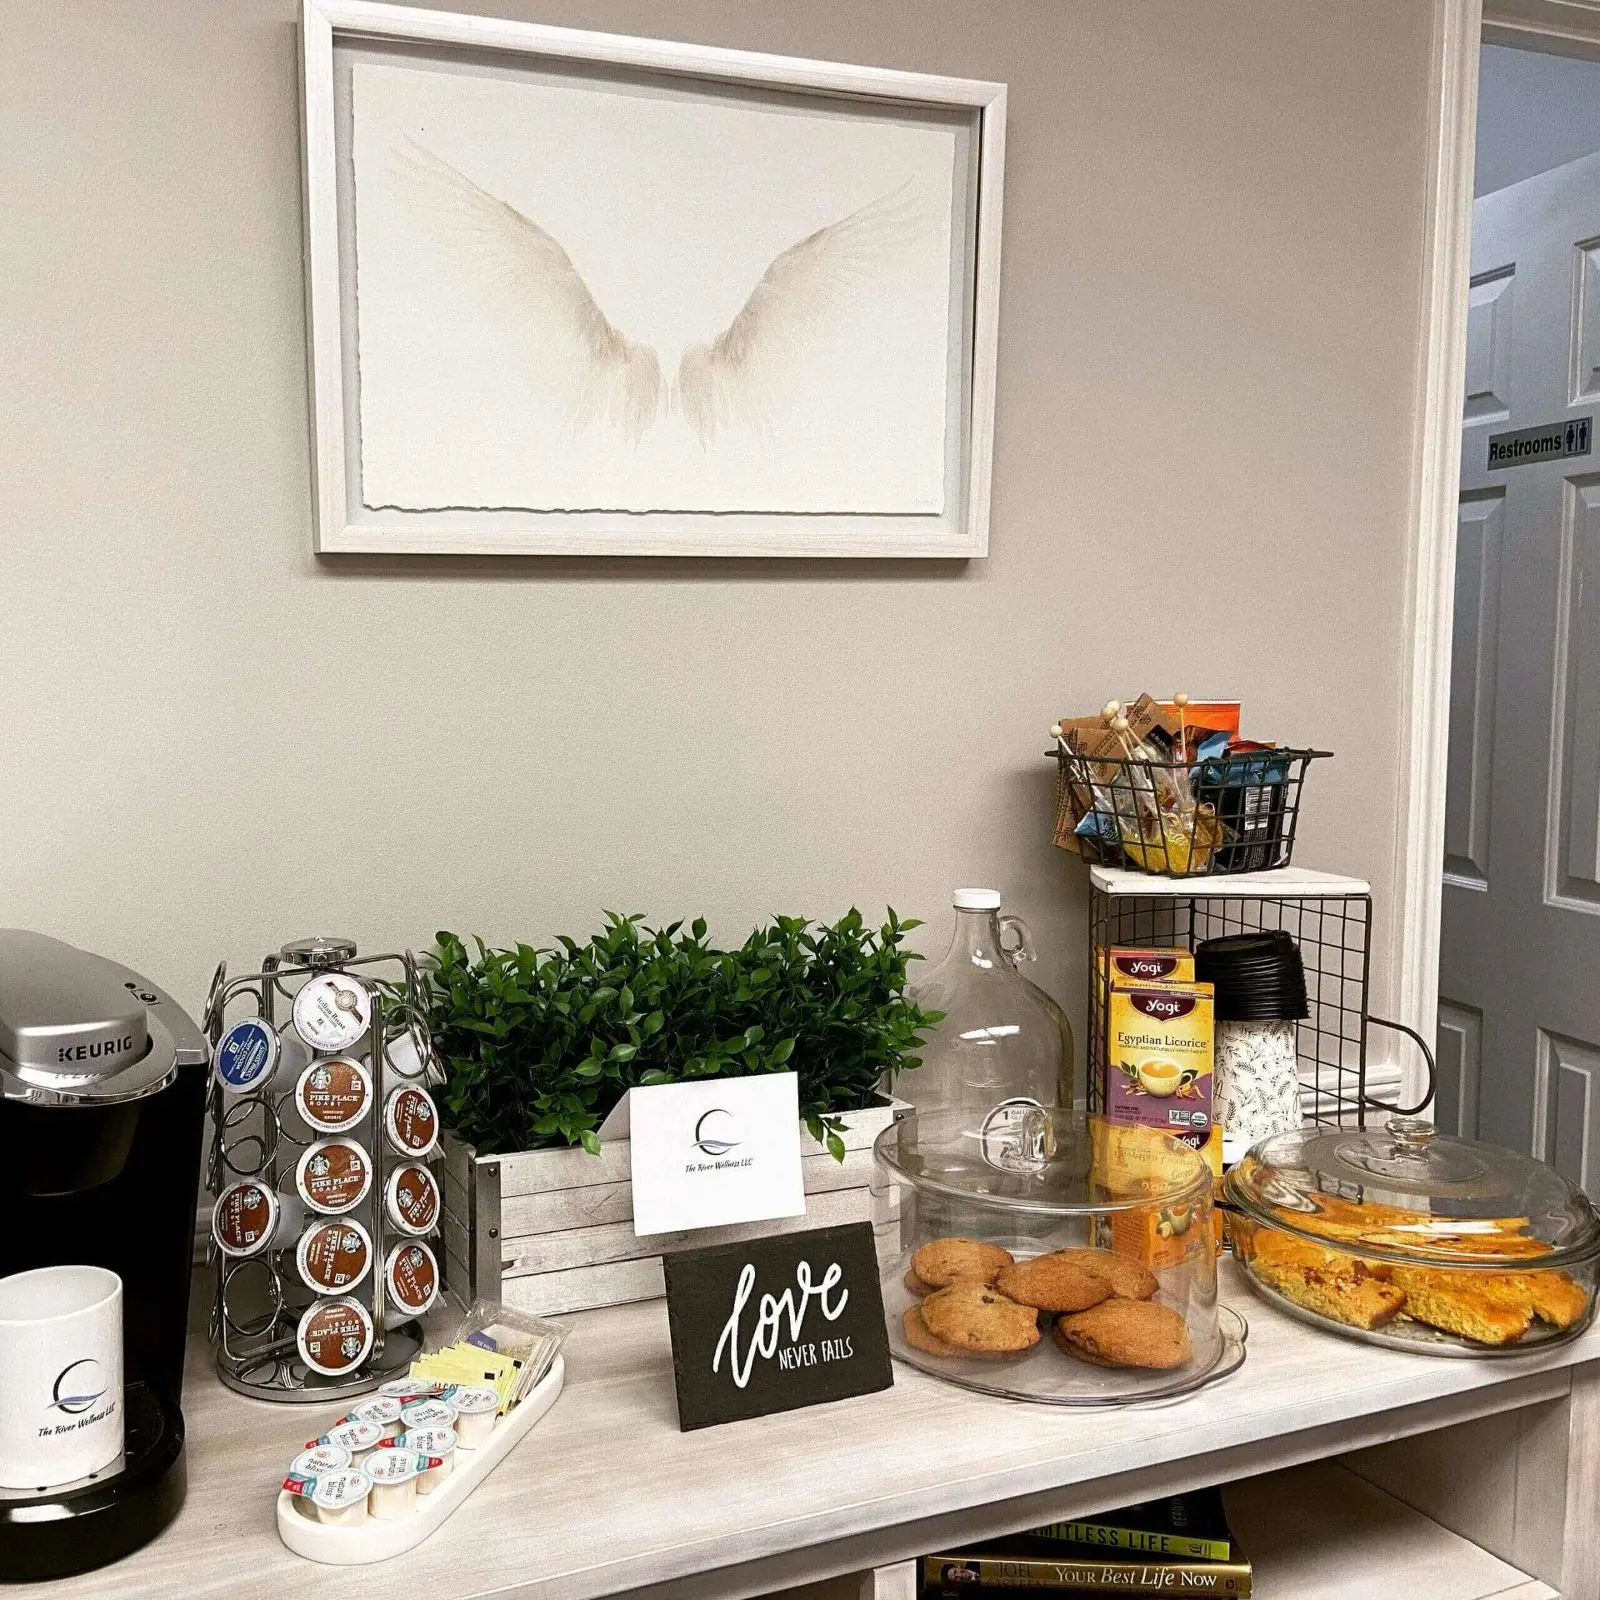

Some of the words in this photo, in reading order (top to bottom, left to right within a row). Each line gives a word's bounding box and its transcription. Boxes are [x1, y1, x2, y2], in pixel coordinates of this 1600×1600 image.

[1490, 435, 1561, 460] Restrooms
[59, 1036, 132, 1062] KEURIG
[1118, 1032, 1161, 1045] Egyptian
[1165, 1036, 1206, 1048] Licorice
[685, 1164, 696, 1173] The
[715, 1160, 739, 1170] Wellness
[741, 1158, 753, 1166] LLC
[311, 1180, 331, 1188] PIKE
[333, 1176, 359, 1185] PLACE
[312, 1328, 339, 1337] PLACE
[712, 1261, 849, 1388] love
[779, 1343, 817, 1370] NEVER
[821, 1336, 853, 1362] FAILS
[38, 1426, 52, 1437] The
[55, 1423, 76, 1435] River
[78, 1413, 105, 1429] Wellness
[305, 1464, 324, 1473] bliss
[308, 1458, 338, 1469] natural
[1128, 1529, 1170, 1553] LIFE
[1000, 1562, 1031, 1577] JOEL
[1101, 1567, 1136, 1584] Best
[1141, 1566, 1175, 1590] Life
